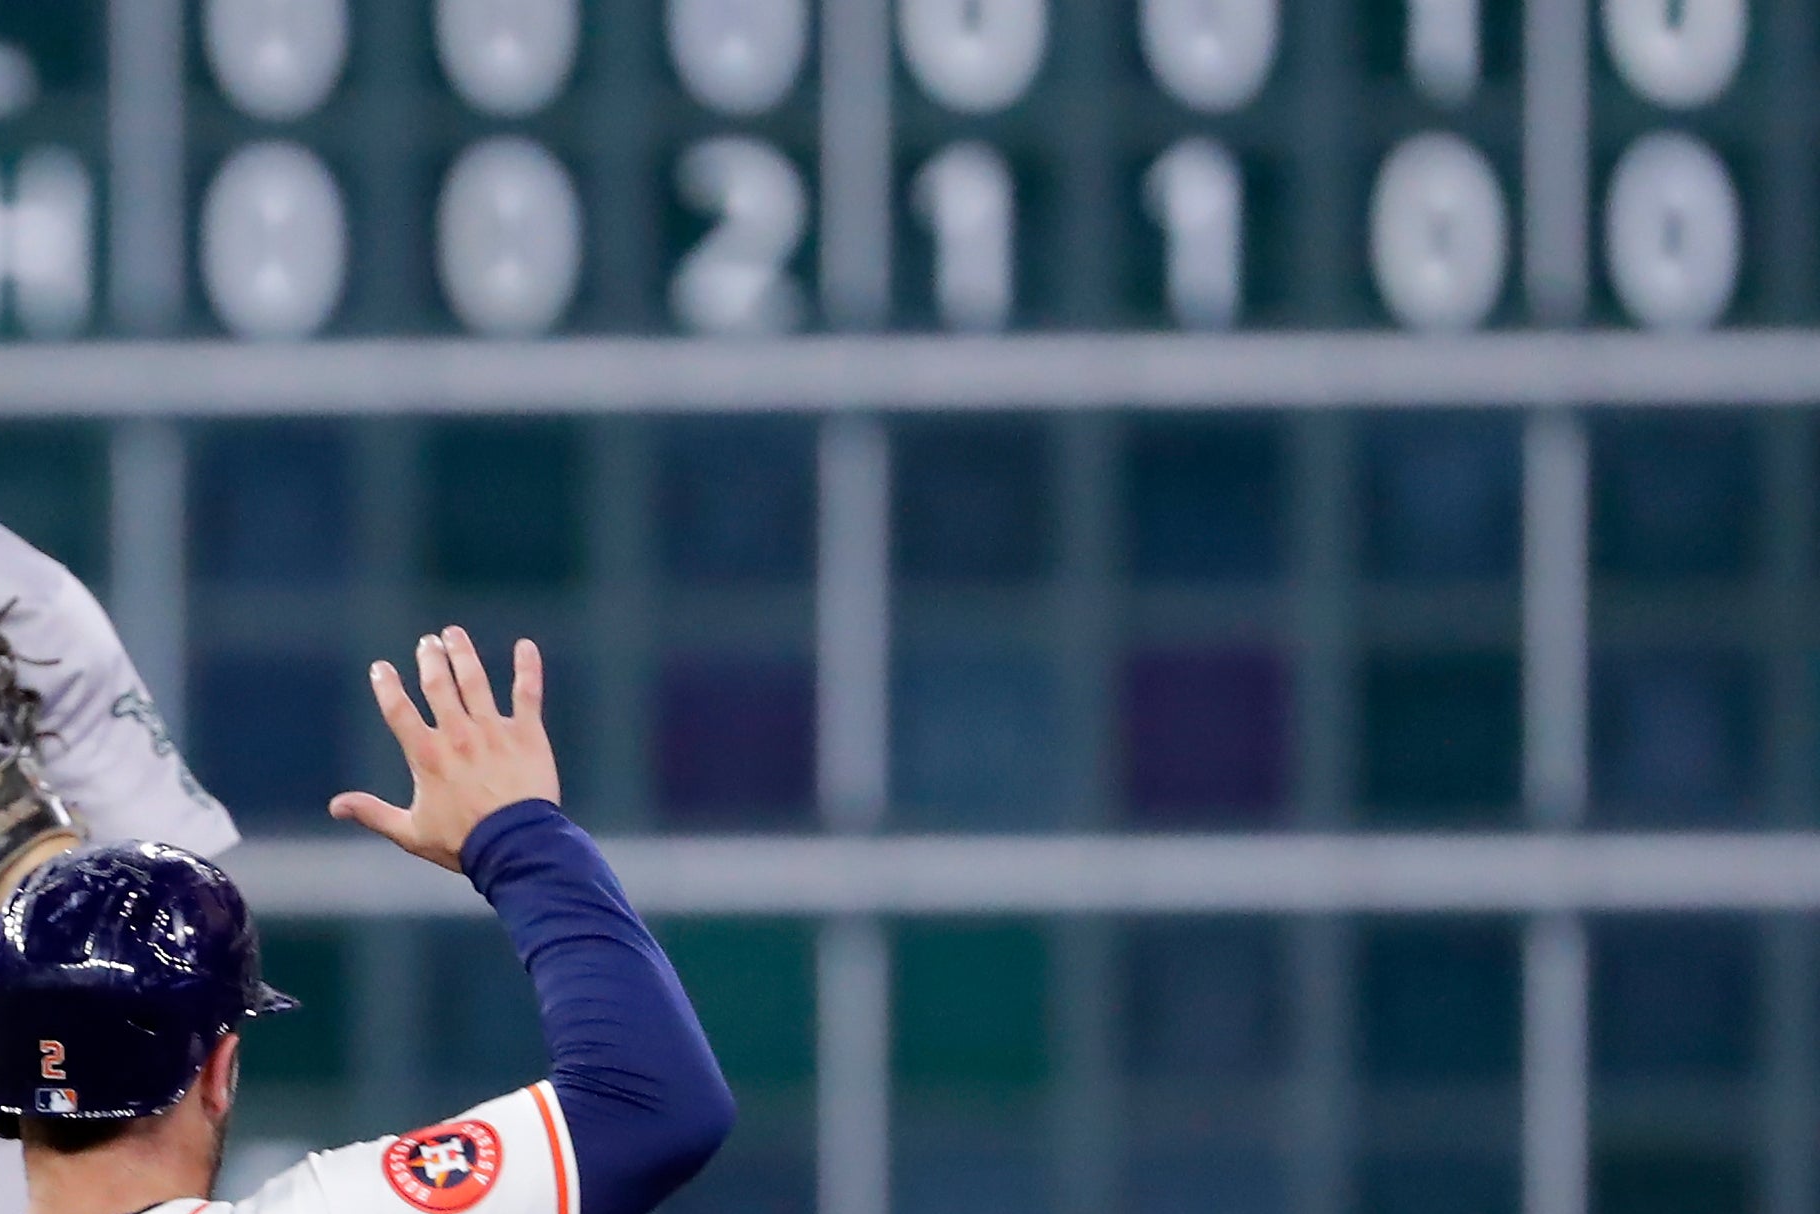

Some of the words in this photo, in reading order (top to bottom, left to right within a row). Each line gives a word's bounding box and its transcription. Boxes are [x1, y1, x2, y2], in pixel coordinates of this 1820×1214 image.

[200, 140, 348, 340] 0
[436, 135, 580, 335] 0
[667, 134, 806, 335] 2
[910, 138, 1016, 333] 1
[1142, 136, 1244, 332] 1
[1368, 132, 1506, 333] 0
[1604, 131, 1742, 332] 0
[39, 1039, 67, 1080] 2
[418, 1136, 470, 1180] H
